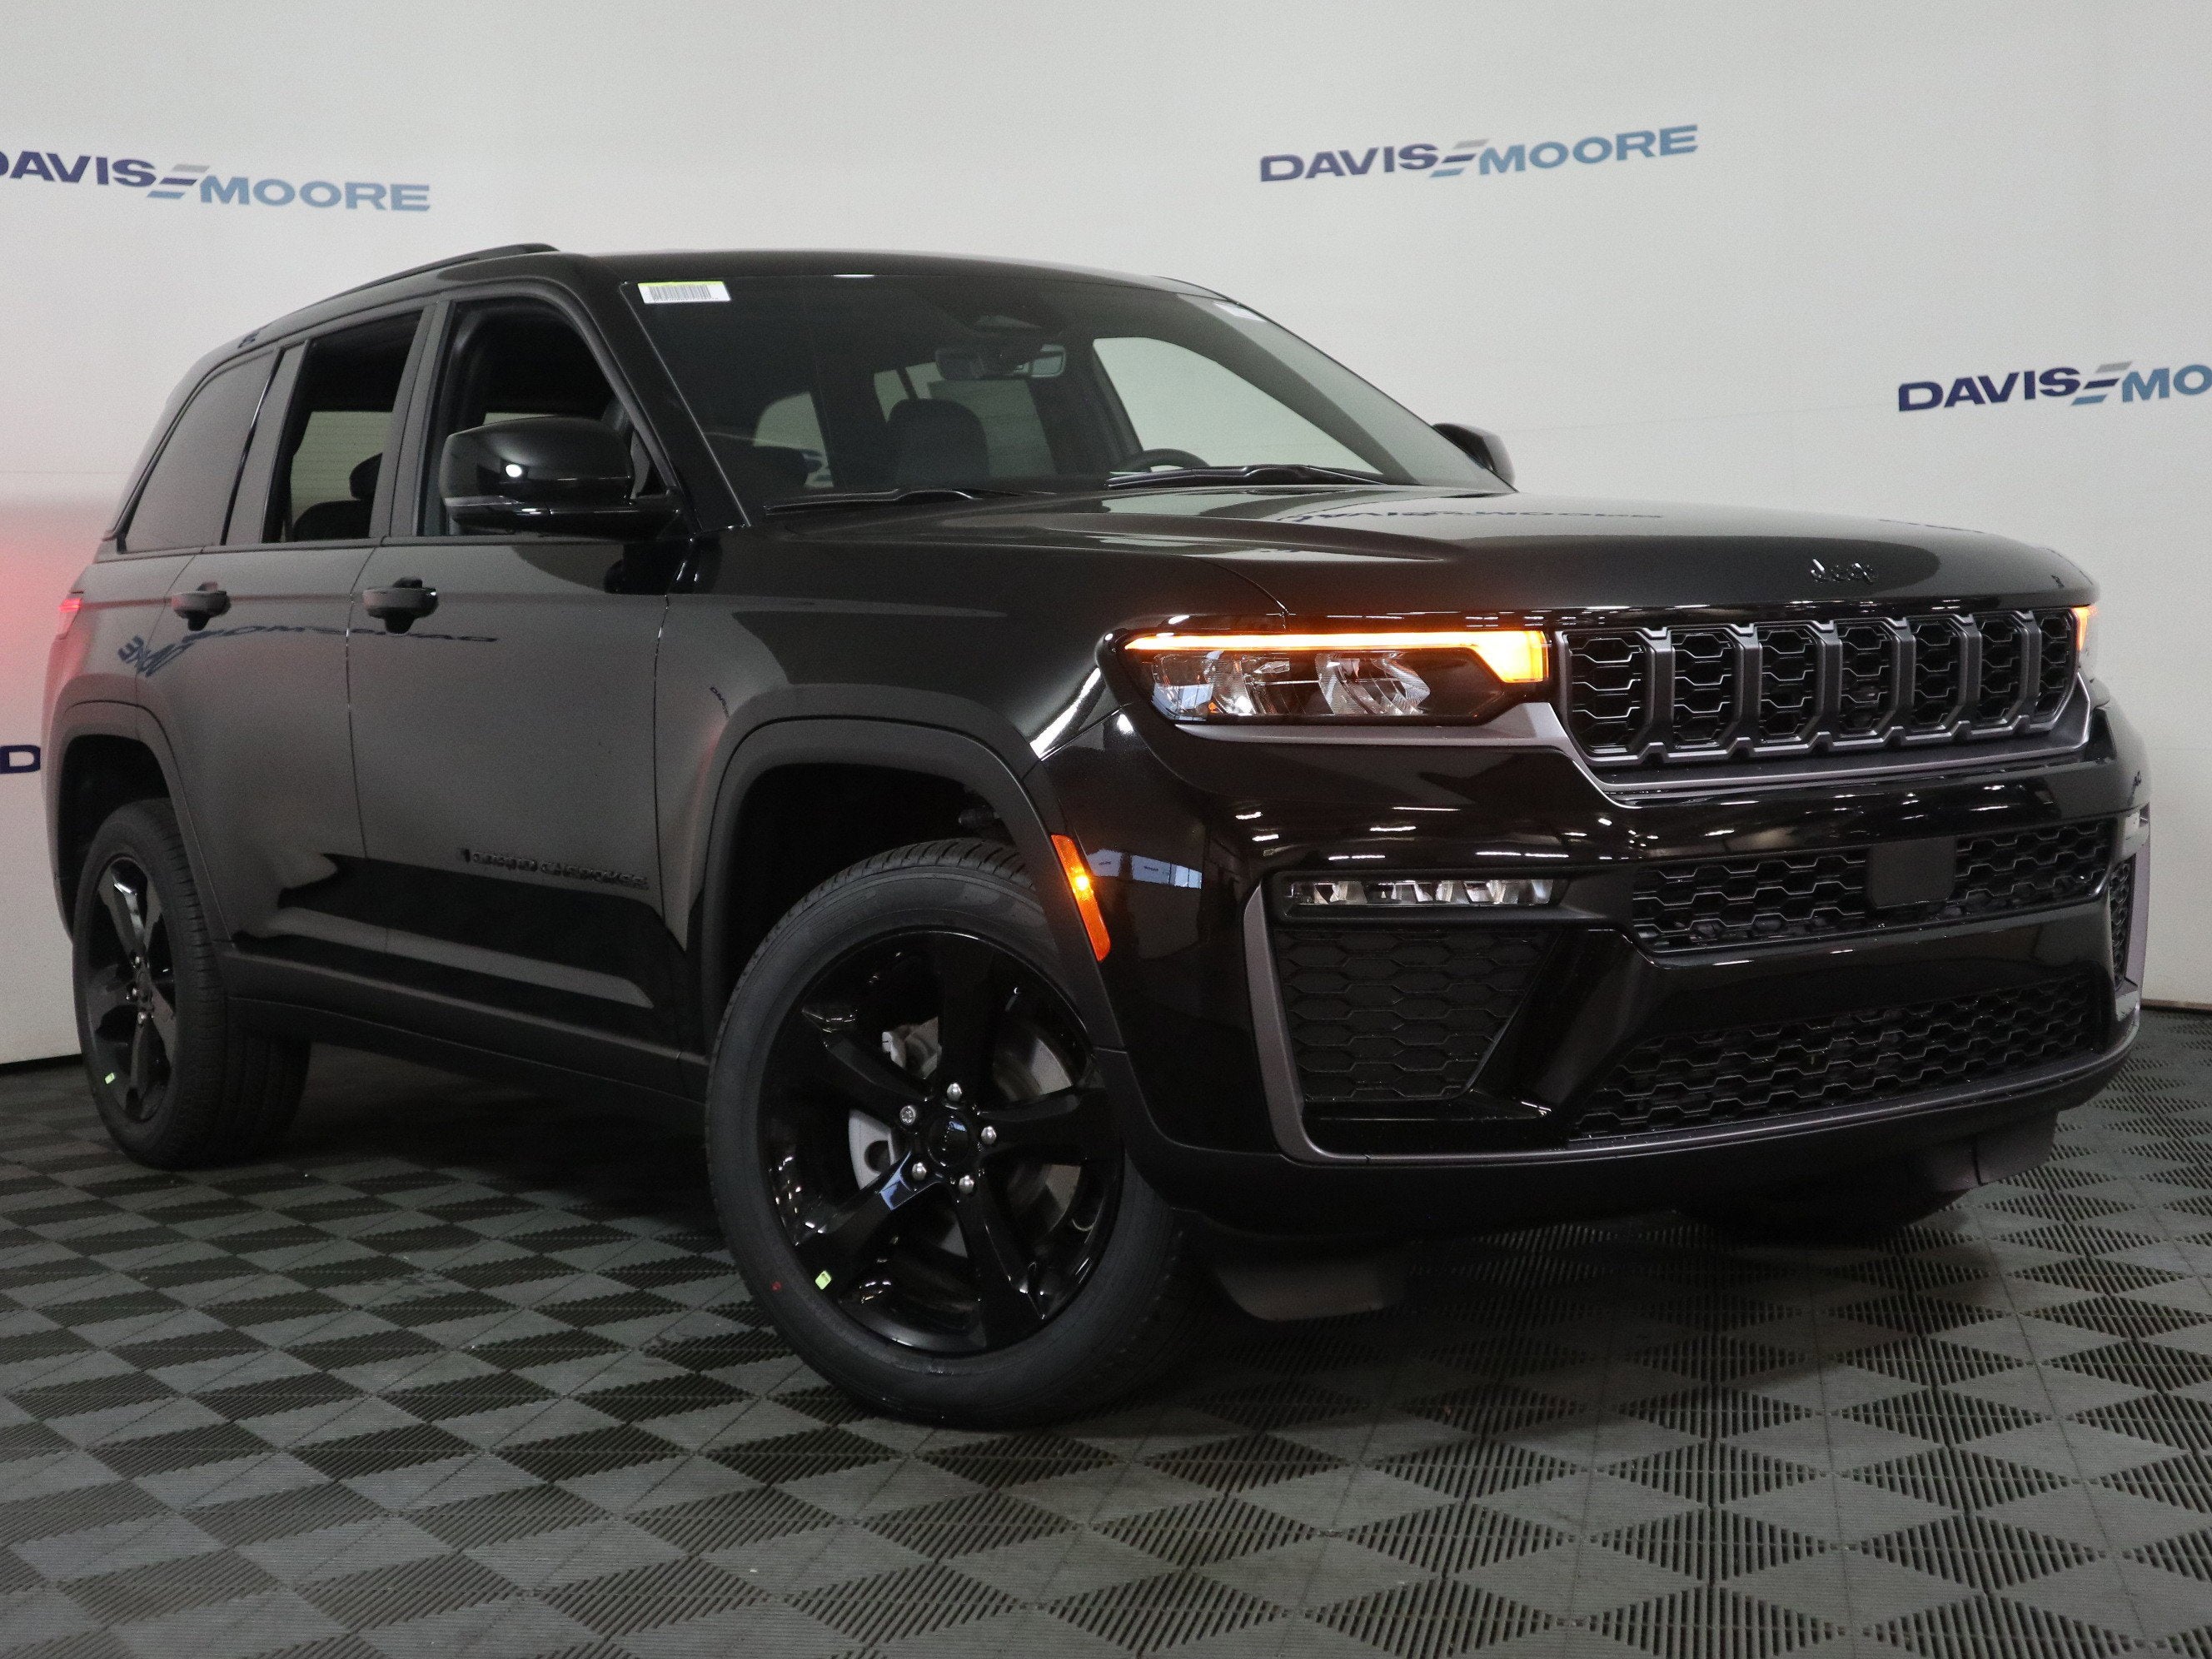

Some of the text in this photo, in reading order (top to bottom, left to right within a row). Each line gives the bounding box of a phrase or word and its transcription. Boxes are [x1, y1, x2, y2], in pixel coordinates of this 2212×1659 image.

[0, 150, 431, 212] AVIS MOORE
[1260, 124, 1698, 182] DAVIS MOORE
[1898, 366, 2081, 412] DAVIS
